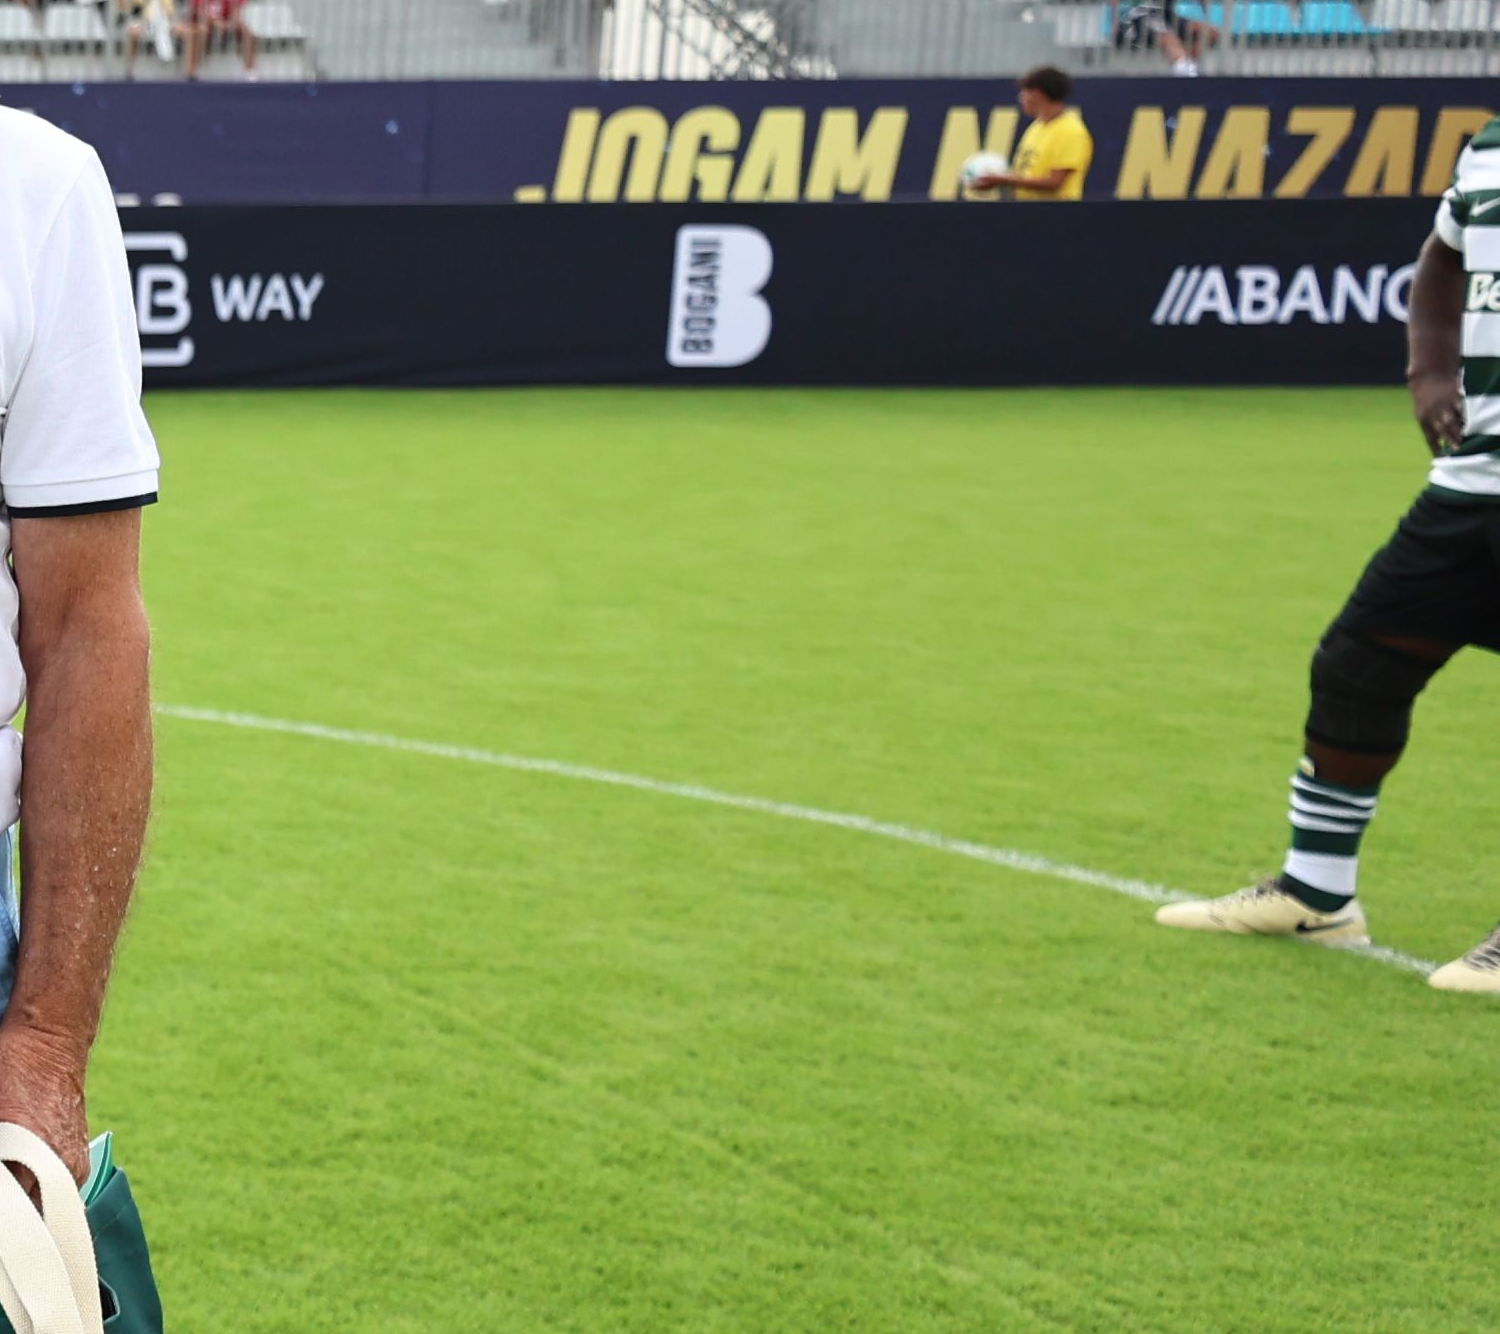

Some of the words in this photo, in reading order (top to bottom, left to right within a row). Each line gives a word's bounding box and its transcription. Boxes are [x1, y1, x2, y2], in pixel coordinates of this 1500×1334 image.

[513, 106, 908, 203] JOGAM
[136, 263, 192, 336] B
[210, 271, 325, 324] WAY
[681, 238, 722, 354] BOGANI
